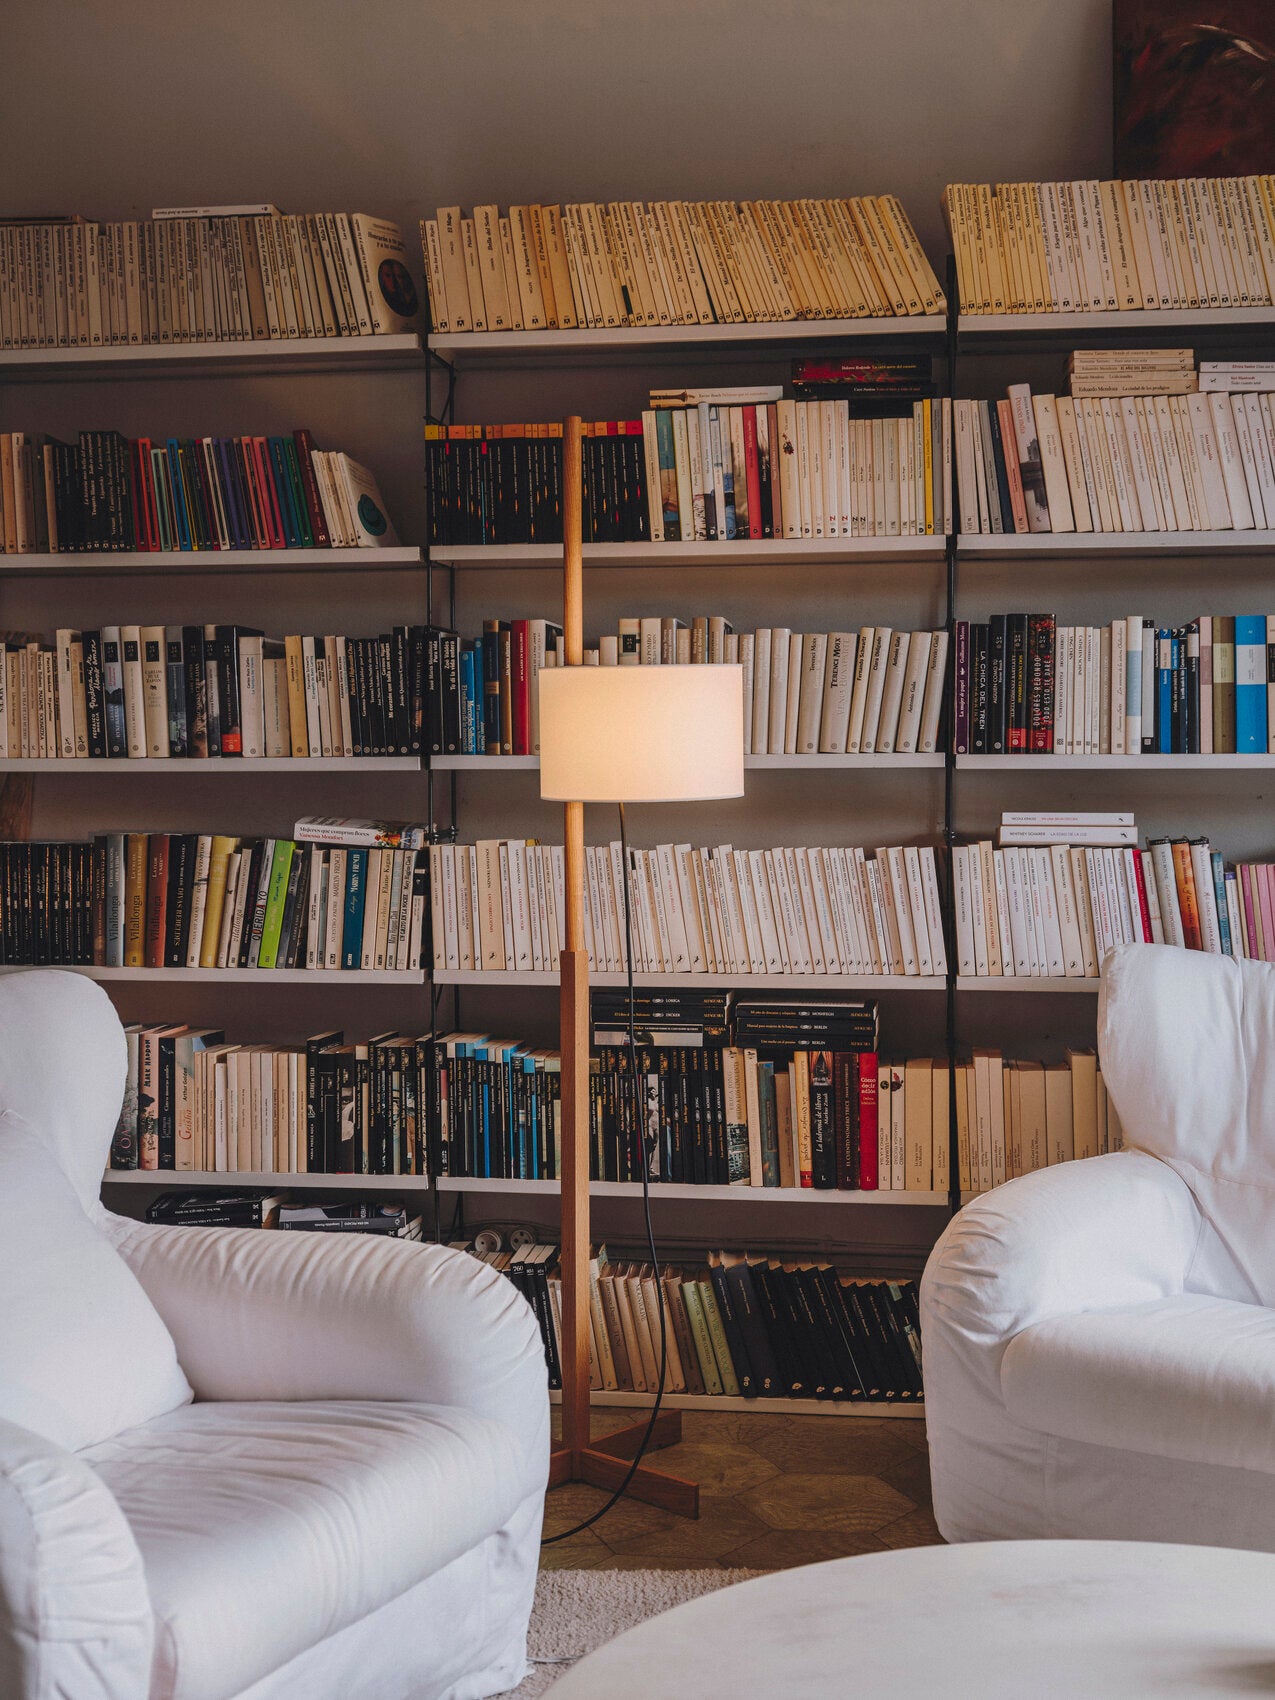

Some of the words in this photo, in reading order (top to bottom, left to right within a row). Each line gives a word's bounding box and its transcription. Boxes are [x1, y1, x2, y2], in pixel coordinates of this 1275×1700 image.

[980, 651, 986, 660] LA
[1033, 657, 1041, 690] REDONDO
[257, 891, 267, 901] YO
[110, 896, 121, 941] Vilallonga
[130, 895, 142, 940] Vilallonga
[151, 896, 162, 941] Vilallonga
[252, 904, 266, 940] QUERIDA
[179, 1110, 192, 1140] Geisha
[816, 1144, 823, 1152] La
